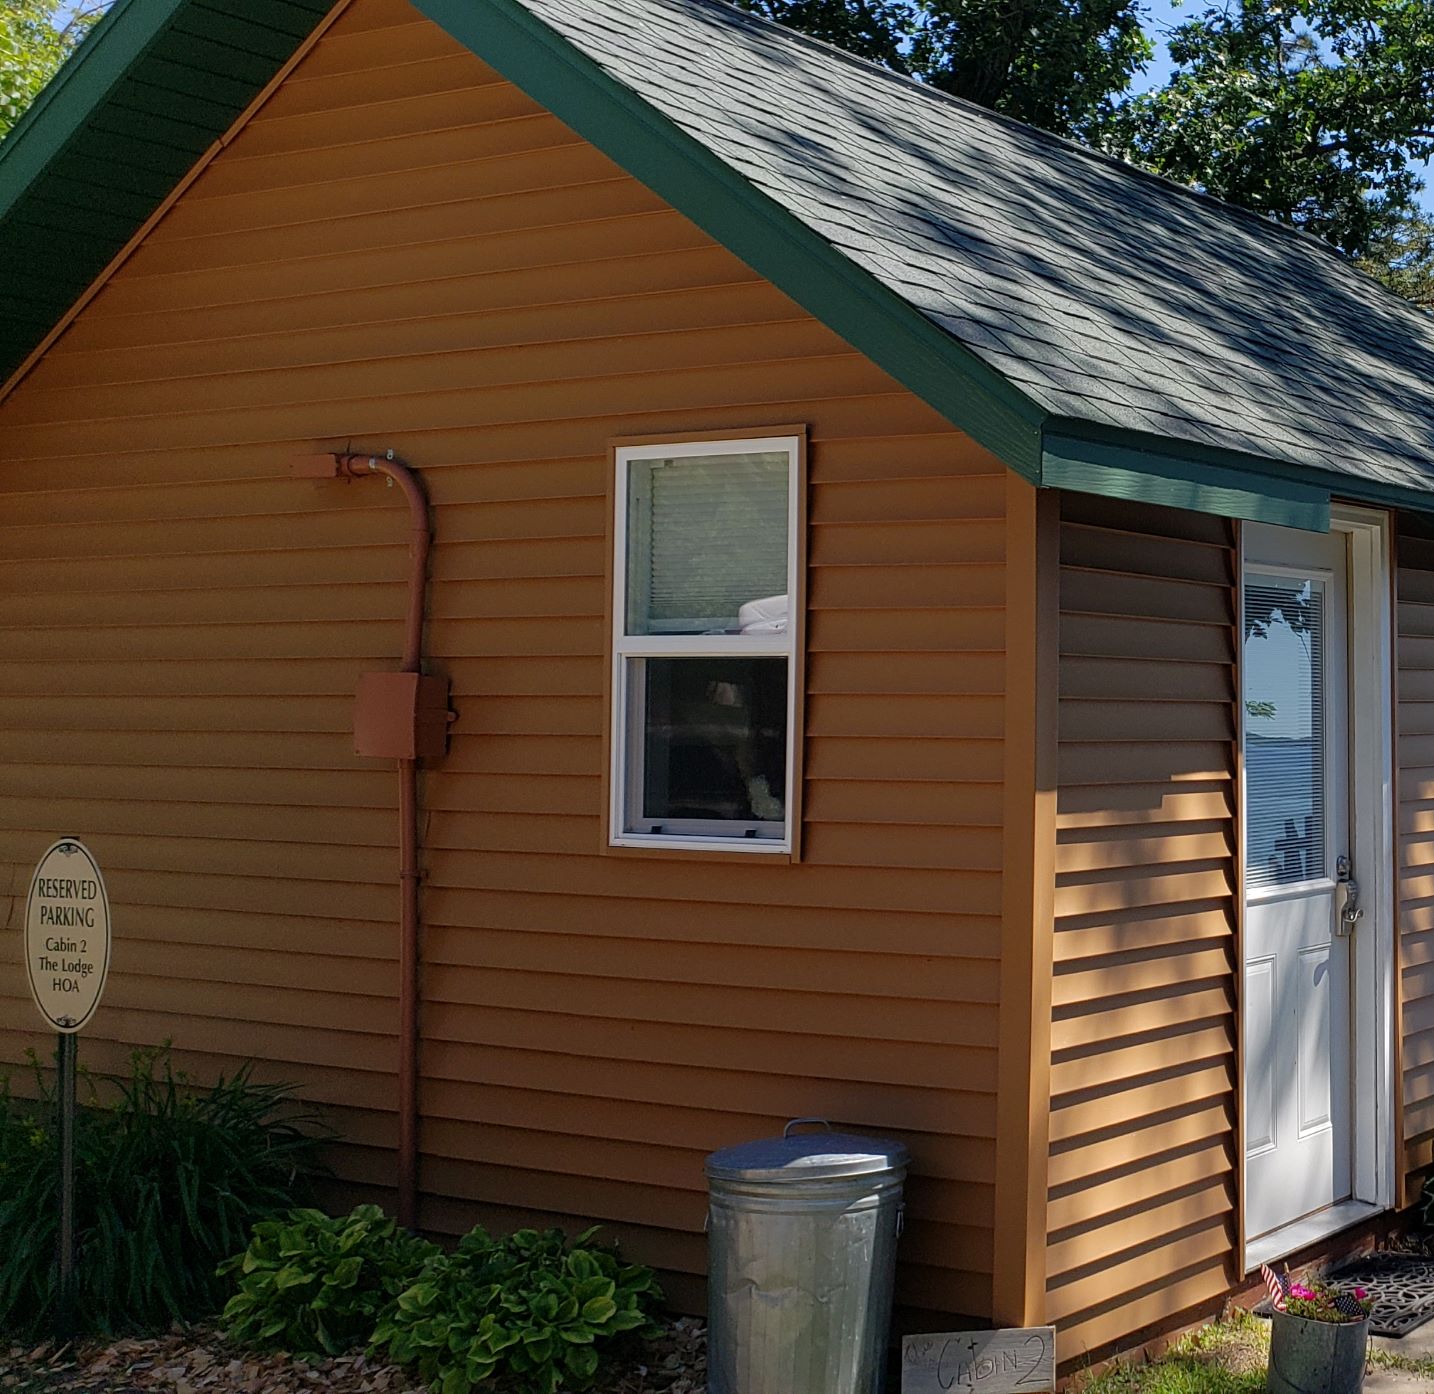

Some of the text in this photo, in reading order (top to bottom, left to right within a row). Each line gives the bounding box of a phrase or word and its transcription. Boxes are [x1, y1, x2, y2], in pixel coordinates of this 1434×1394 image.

[38, 878, 97, 900] RESERVED
[40, 905, 94, 928] PARKING
[45, 937, 87, 953] Cabin 2
[38, 957, 93, 979] The Lodge
[52, 978, 80, 993] HOA
[1015, 1335, 1050, 1386] 2
